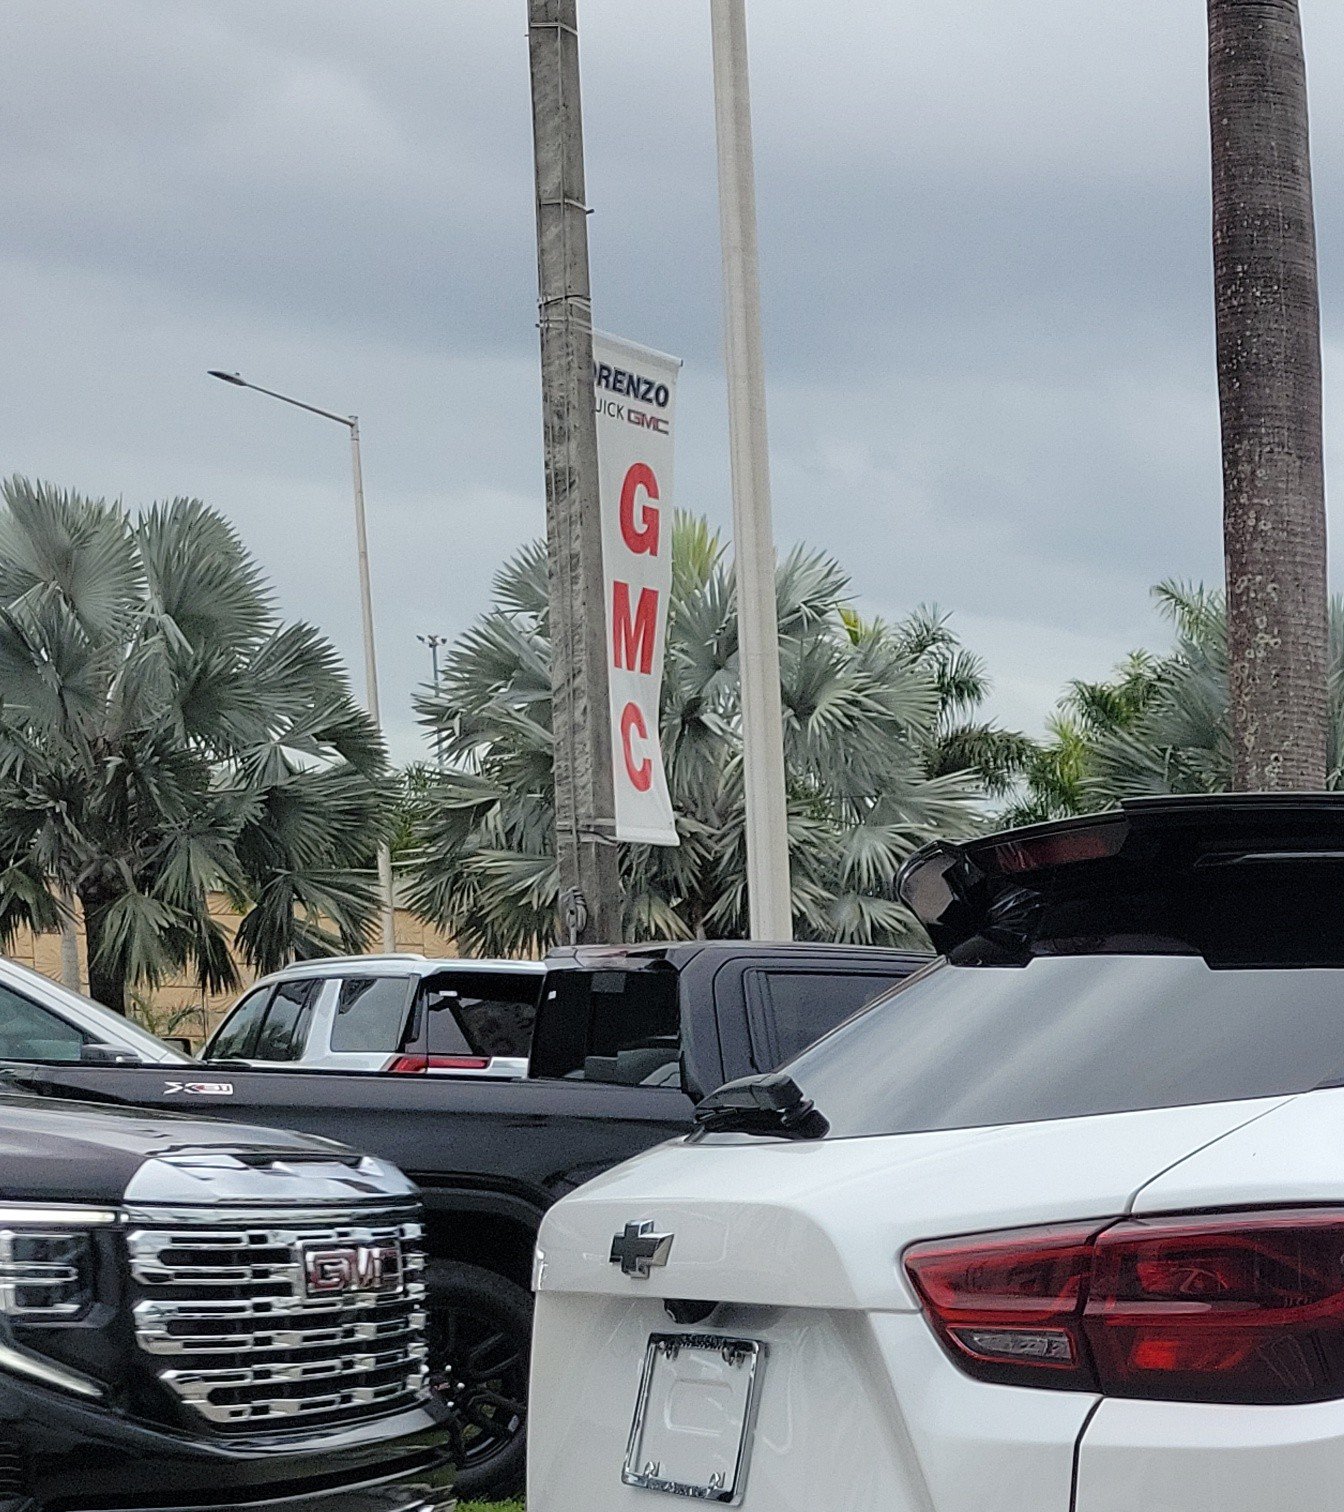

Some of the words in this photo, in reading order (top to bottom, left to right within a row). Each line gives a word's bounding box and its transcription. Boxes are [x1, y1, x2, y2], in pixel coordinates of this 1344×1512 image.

[594, 362, 670, 408] RENZO
[627, 408, 670, 436] GMC
[304, 1246, 402, 1294] GMC
